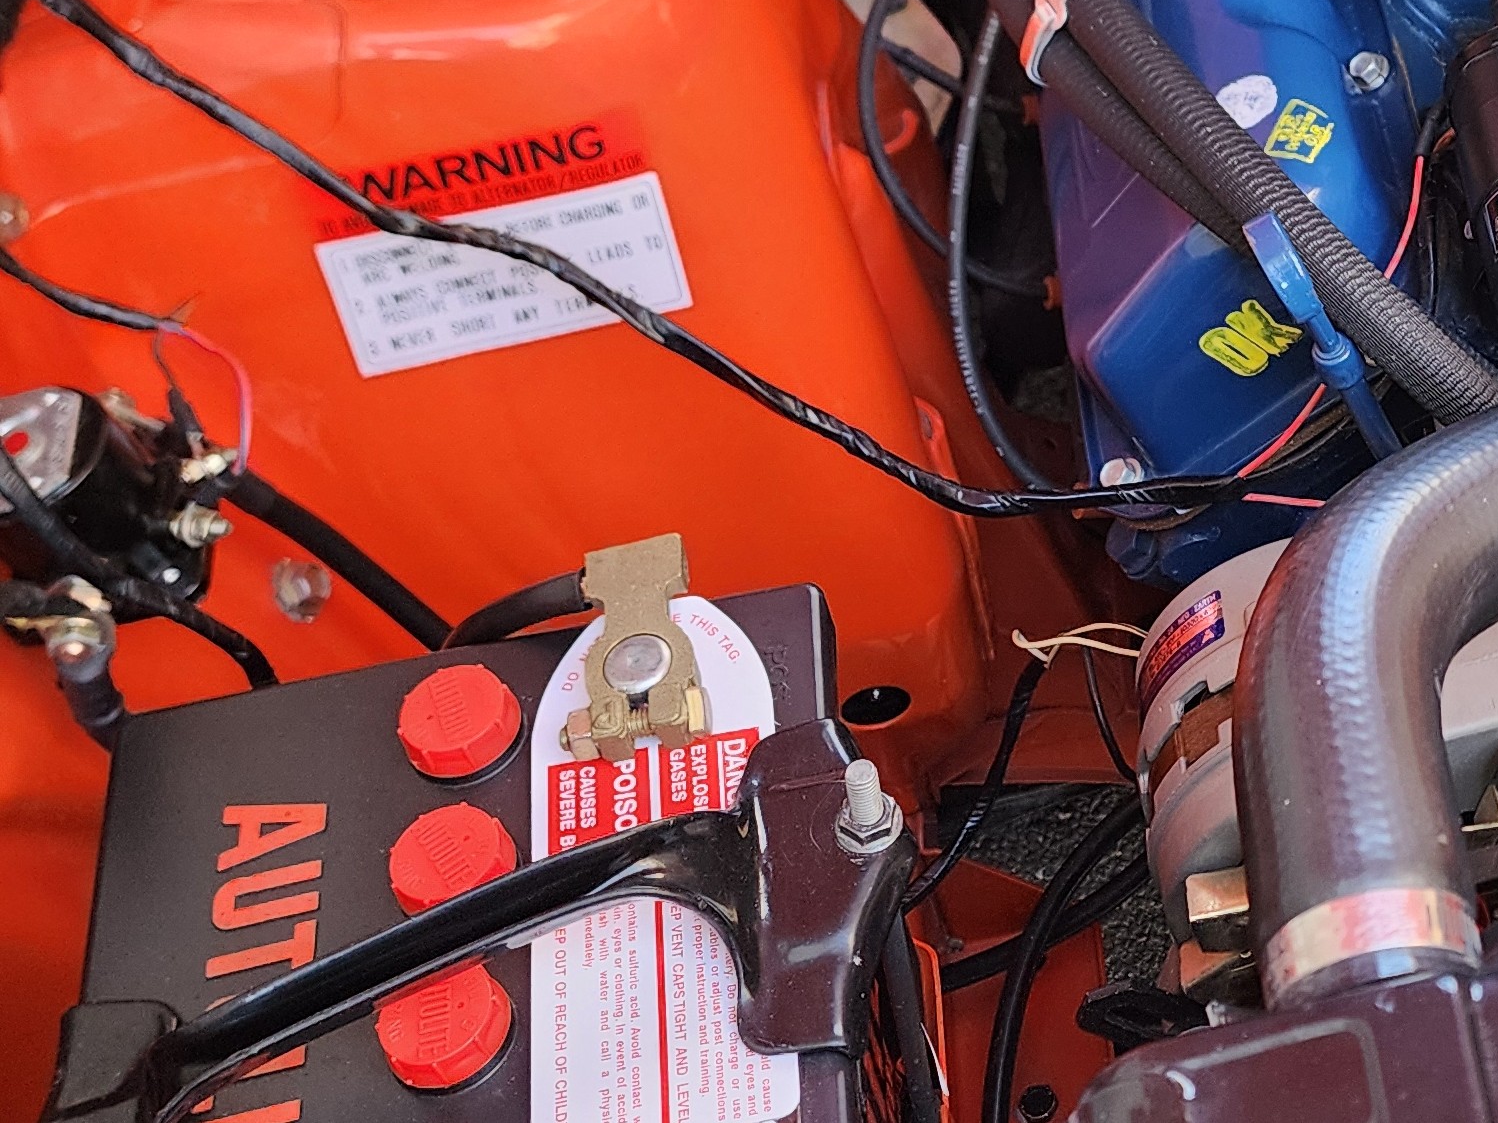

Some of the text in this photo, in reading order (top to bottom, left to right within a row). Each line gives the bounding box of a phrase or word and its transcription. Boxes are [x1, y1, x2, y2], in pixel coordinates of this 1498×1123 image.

[361, 126, 606, 202] WARNING
[1199, 299, 1305, 376] OK
[690, 614, 720, 637] THIS
[561, 672, 579, 692] DO
[669, 748, 688, 803] GASES
[690, 744, 710, 812] EXPLOSI
[558, 768, 576, 832] SEVERE
[579, 766, 597, 830] CAUSES
[613, 758, 638, 833] POISO
[627, 902, 637, 942] ontains
[598, 937, 610, 962] with
[612, 928, 622, 954] eyes
[671, 923, 684, 958] VENT
[554, 949, 567, 977] OUT
[614, 957, 623, 969] or
[629, 949, 640, 990] sulfuric
[711, 965, 719, 977] or
[554, 981, 568, 1000] OF
[599, 970, 611, 1002] water
[672, 962, 686, 999] CAPS
[727, 983, 737, 1000] Do
[629, 995, 641, 1023] acid.
[692, 922, 710, 1098] proper instruction and training.
[710, 980, 722, 1015] adjust
[554, 1003, 568, 1052] REACH
[600, 1009, 611, 1032] and
[615, 1023, 626, 1036] In
[673, 998, 687, 1042] TIGHT
[728, 1003, 738, 1026] not
[630, 1026, 642, 1059] Avoid
[711, 1019, 723, 1045] post
[554, 1056, 568, 1076] OF
[600, 1040, 612, 1062] call
[615, 1040, 627, 1073] event
[675, 1046, 689, 1077] AND
[728, 1030, 740, 1070] charge
[601, 1069, 611, 1078] a
[616, 1076, 628, 1089] of
[631, 1065, 643, 1110] contact
[715, 1050, 726, 1122] connections
[731, 1077, 740, 1091] or
[744, 1062, 755, 1091] eyes
[554, 1078, 569, 1123] CHILD
[598, 1087, 611, 1123] physi
[732, 1098, 741, 1120] use
[747, 1094, 756, 1117] and
[762, 1077, 772, 1113] cause
